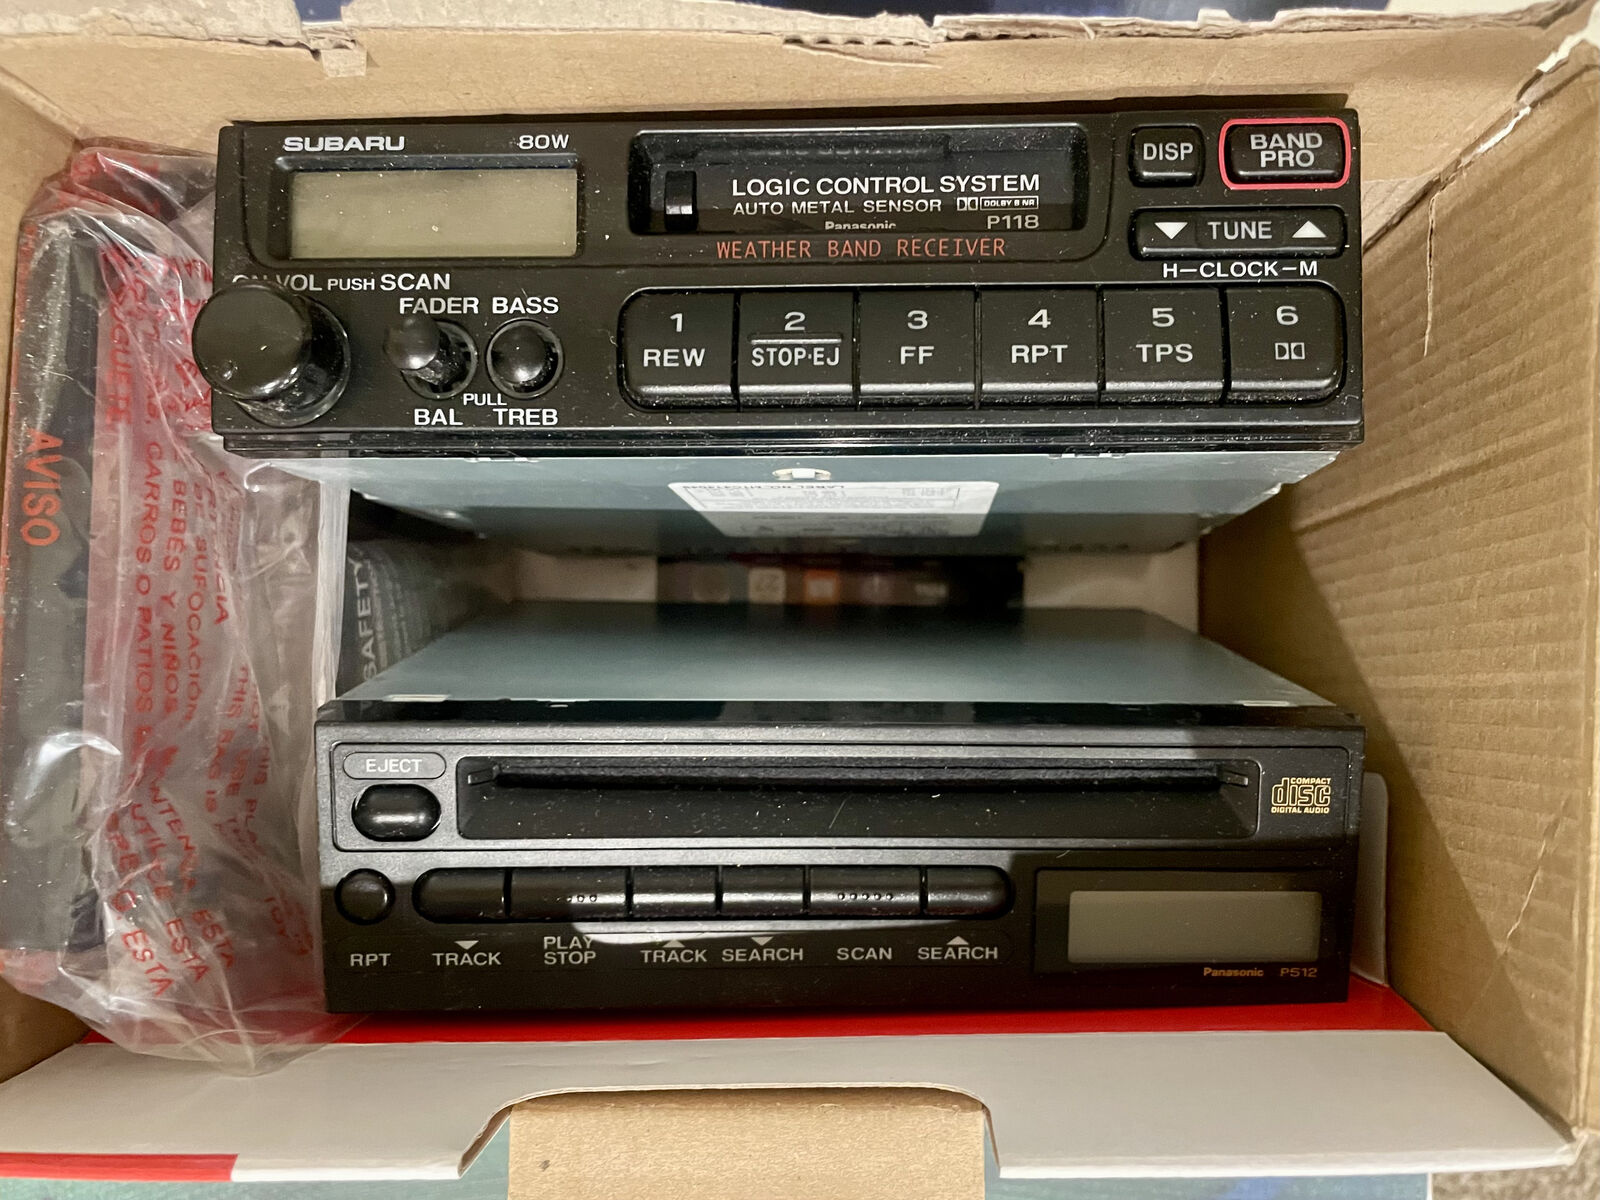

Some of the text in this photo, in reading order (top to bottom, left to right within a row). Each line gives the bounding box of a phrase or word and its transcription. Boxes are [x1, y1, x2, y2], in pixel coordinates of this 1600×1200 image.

[283, 136, 405, 152] SUBARU
[518, 134, 570, 150] 80W
[1250, 133, 1323, 150] BAND
[1143, 143, 1194, 161] DISP
[1260, 150, 1315, 168] PRO
[732, 174, 1041, 196] LOGIC CONTROL SYSTEM
[733, 199, 942, 215] AUTO METAL SENSOR
[983, 199, 1012, 207] DOLBY
[986, 215, 1040, 230] P118
[1207, 221, 1273, 241] TUNE
[716, 238, 1006, 259] WEATHER BAND RECEIVER
[327, 278, 376, 291] PUSH
[380, 273, 452, 291] SCAN
[399, 297, 480, 314] FADER
[492, 297, 560, 314] BASS
[670, 313, 683, 332] 1
[783, 311, 806, 331] 2
[907, 310, 928, 330] 3
[1027, 308, 1052, 329] 4
[1152, 307, 1175, 328] 5
[1276, 306, 1299, 326] 6
[642, 348, 706, 368] REW
[900, 346, 936, 365] FF
[1011, 344, 1069, 364] RPT
[1136, 344, 1194, 363] TPS
[463, 393, 508, 406] PULL
[414, 409, 464, 426] BAL
[493, 408, 559, 426] TREB
[21, 427, 64, 547] AVISO
[135, 440, 163, 564] CARROS
[135, 573, 151, 597] O
[161, 590, 179, 609] Y
[346, 556, 377, 682] SAFETY
[135, 604, 154, 715] PATIOS
[365, 758, 425, 774] EJECT
[1290, 777, 1332, 785] COMPACT
[1271, 776, 1331, 807] disc
[1271, 806, 1330, 814] DIGITAL AUDIO
[191, 909, 235, 970] ESTA
[543, 936, 595, 950] PLAY
[165, 917, 211, 984] ESTA
[431, 951, 502, 967] TRACK
[543, 950, 597, 966] STOP
[640, 949, 708, 964] TRACK
[721, 948, 805, 963] SEARCH
[836, 946, 894, 962] SCAN
[917, 945, 1000, 961] SEARCH
[120, 927, 175, 1000] ESTA
[349, 952, 392, 968] RPT
[1203, 966, 1319, 978] Panasonic P512
